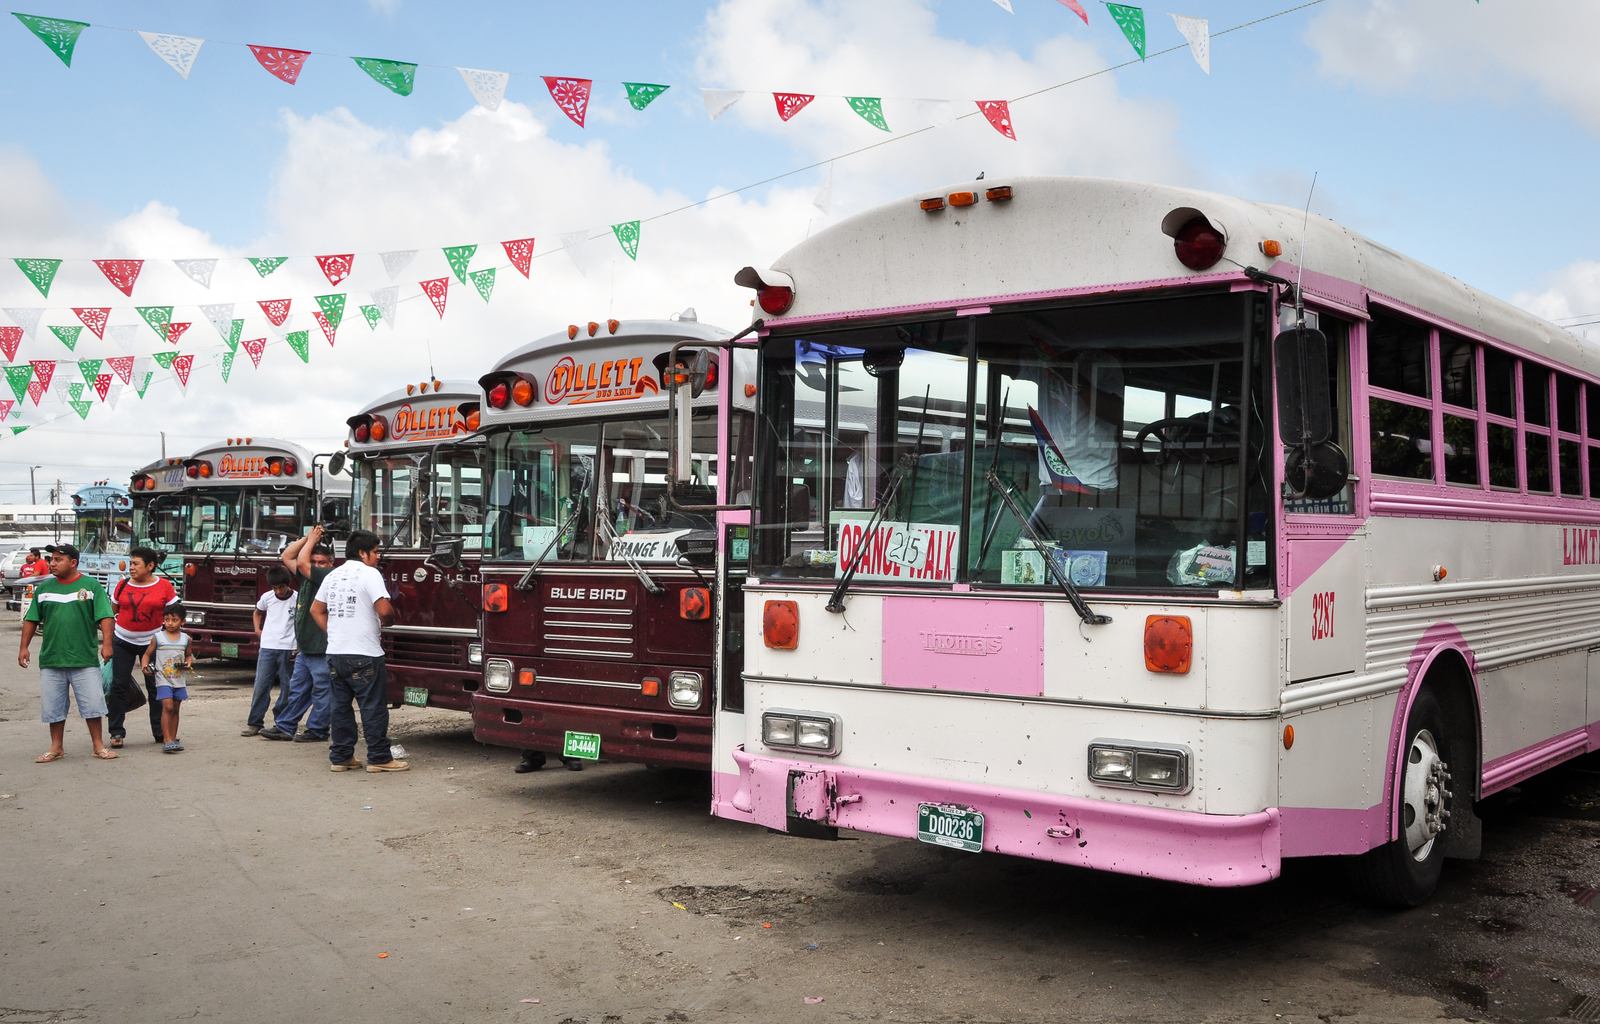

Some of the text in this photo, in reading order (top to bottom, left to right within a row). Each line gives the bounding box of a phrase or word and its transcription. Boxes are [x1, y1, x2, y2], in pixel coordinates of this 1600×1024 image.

[552, 356, 643, 393] TILLETT
[397, 406, 456, 432] TILLETT
[890, 532, 921, 564] 215
[550, 588, 627, 600] BLUE BIRD
[1312, 592, 1335, 640] 3287
[920, 633, 1003, 654] Thomas
[929, 814, 973, 840] D00236
